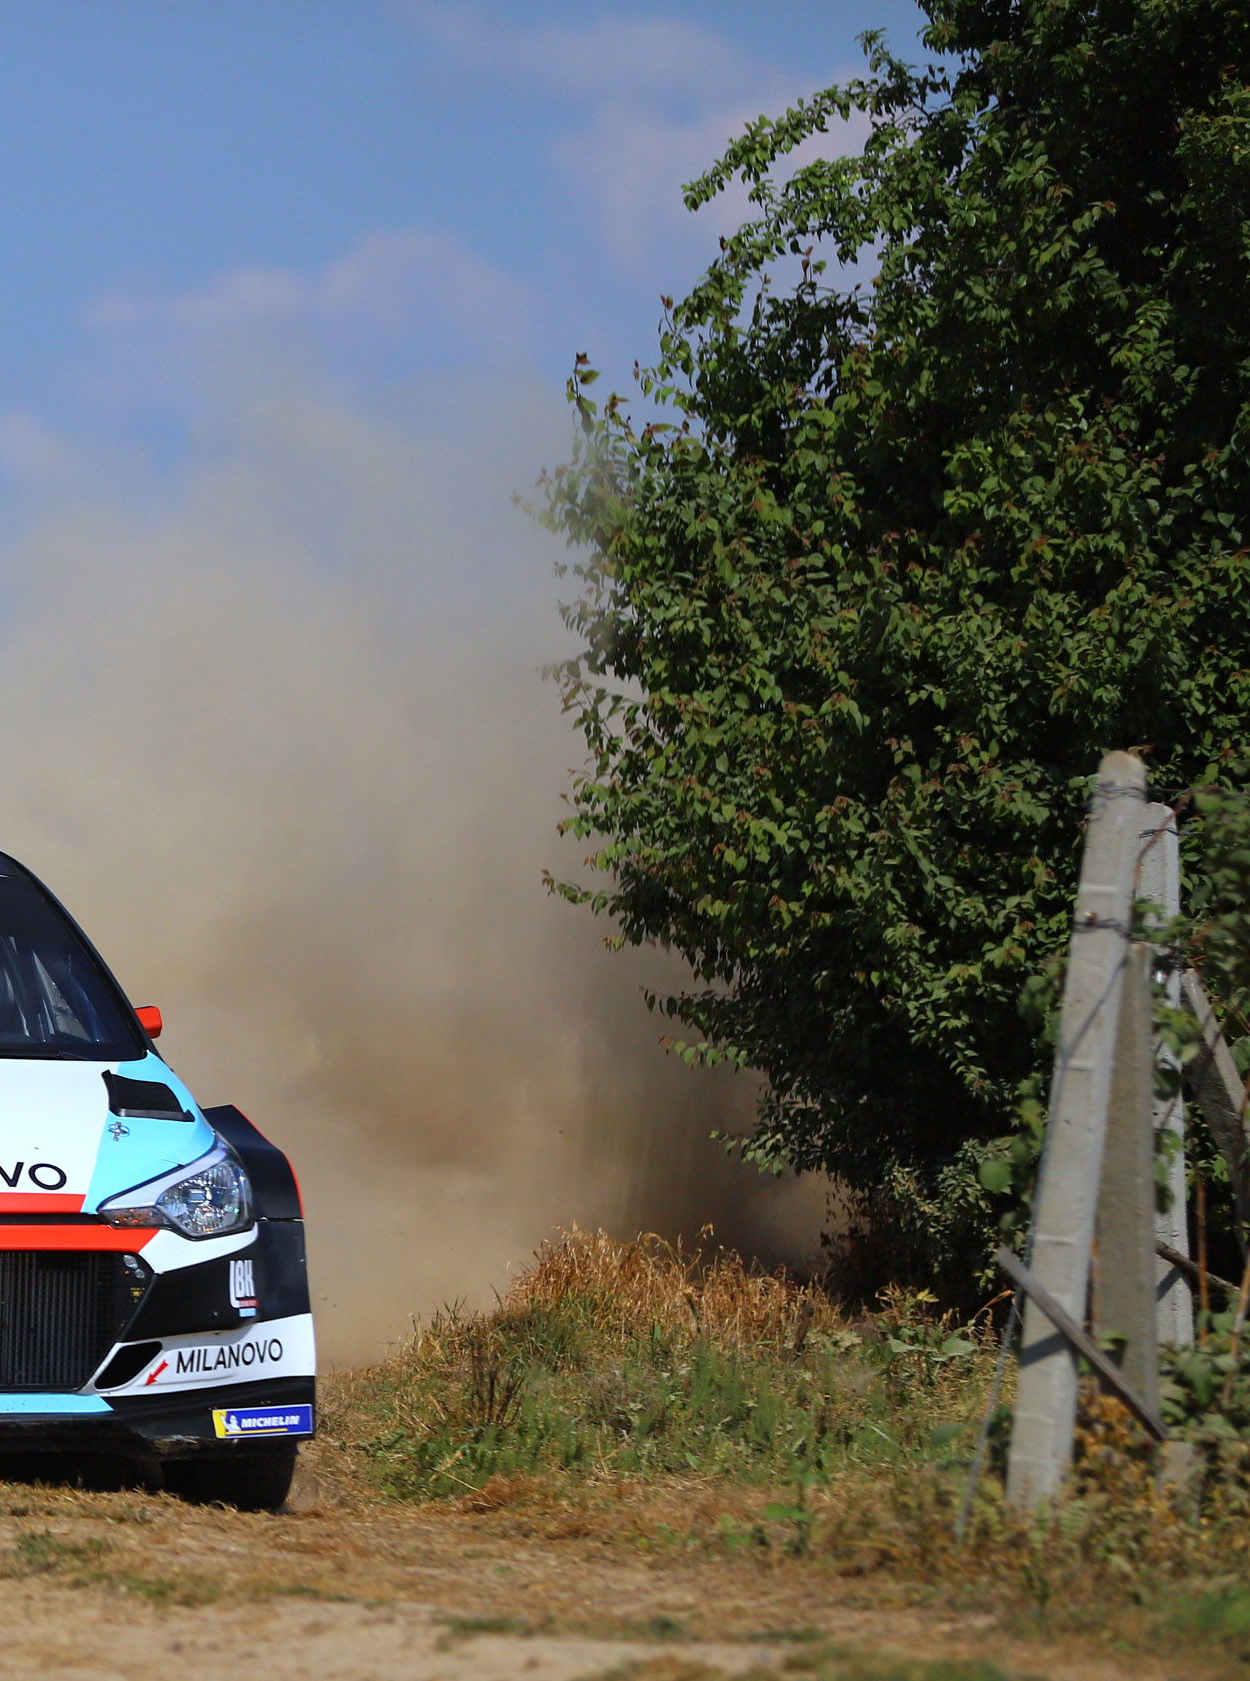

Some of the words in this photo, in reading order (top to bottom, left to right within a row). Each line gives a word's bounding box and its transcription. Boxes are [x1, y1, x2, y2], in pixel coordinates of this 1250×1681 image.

[229, 1260, 255, 1308] LBK
[176, 1338, 284, 1374] MILANOVO
[241, 1415, 300, 1429] MICHELIN
